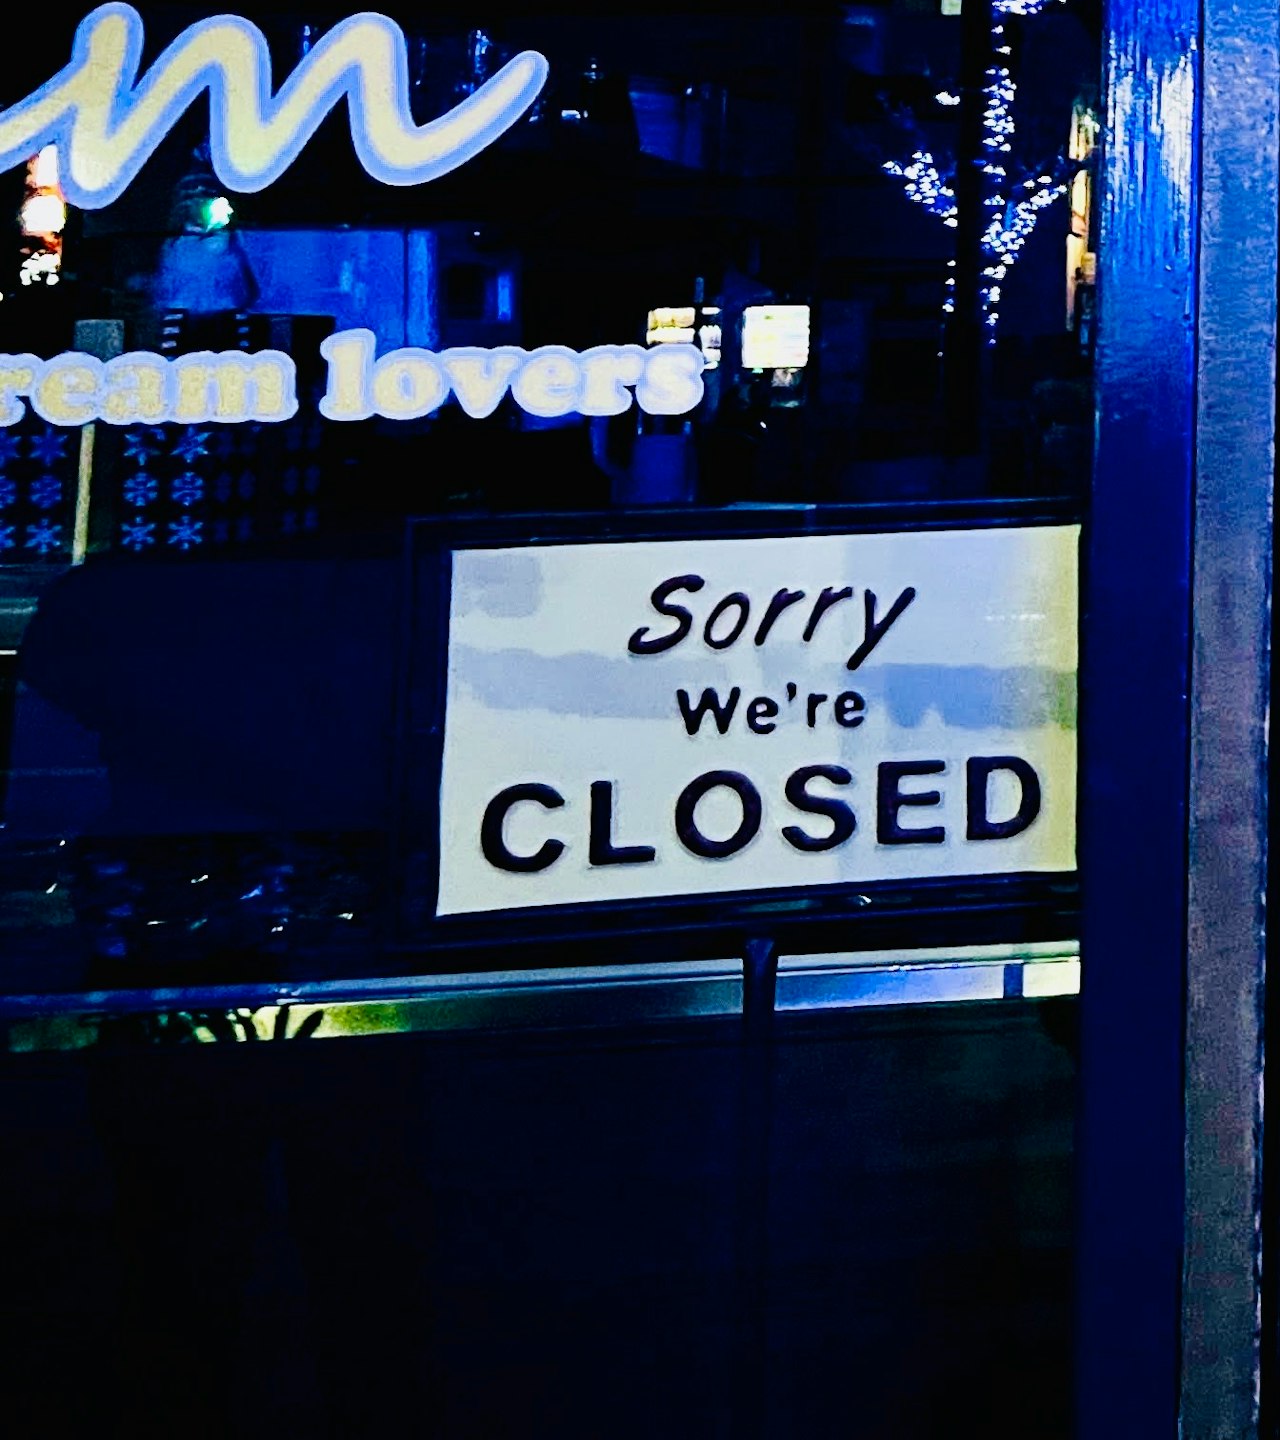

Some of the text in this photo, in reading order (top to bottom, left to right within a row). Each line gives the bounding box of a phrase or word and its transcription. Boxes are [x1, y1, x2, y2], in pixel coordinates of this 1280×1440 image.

[320, 328, 704, 422] lovers
[627, 574, 916, 671] Sorry
[676, 682, 866, 736] We're
[480, 755, 1042, 873] CLOSED
